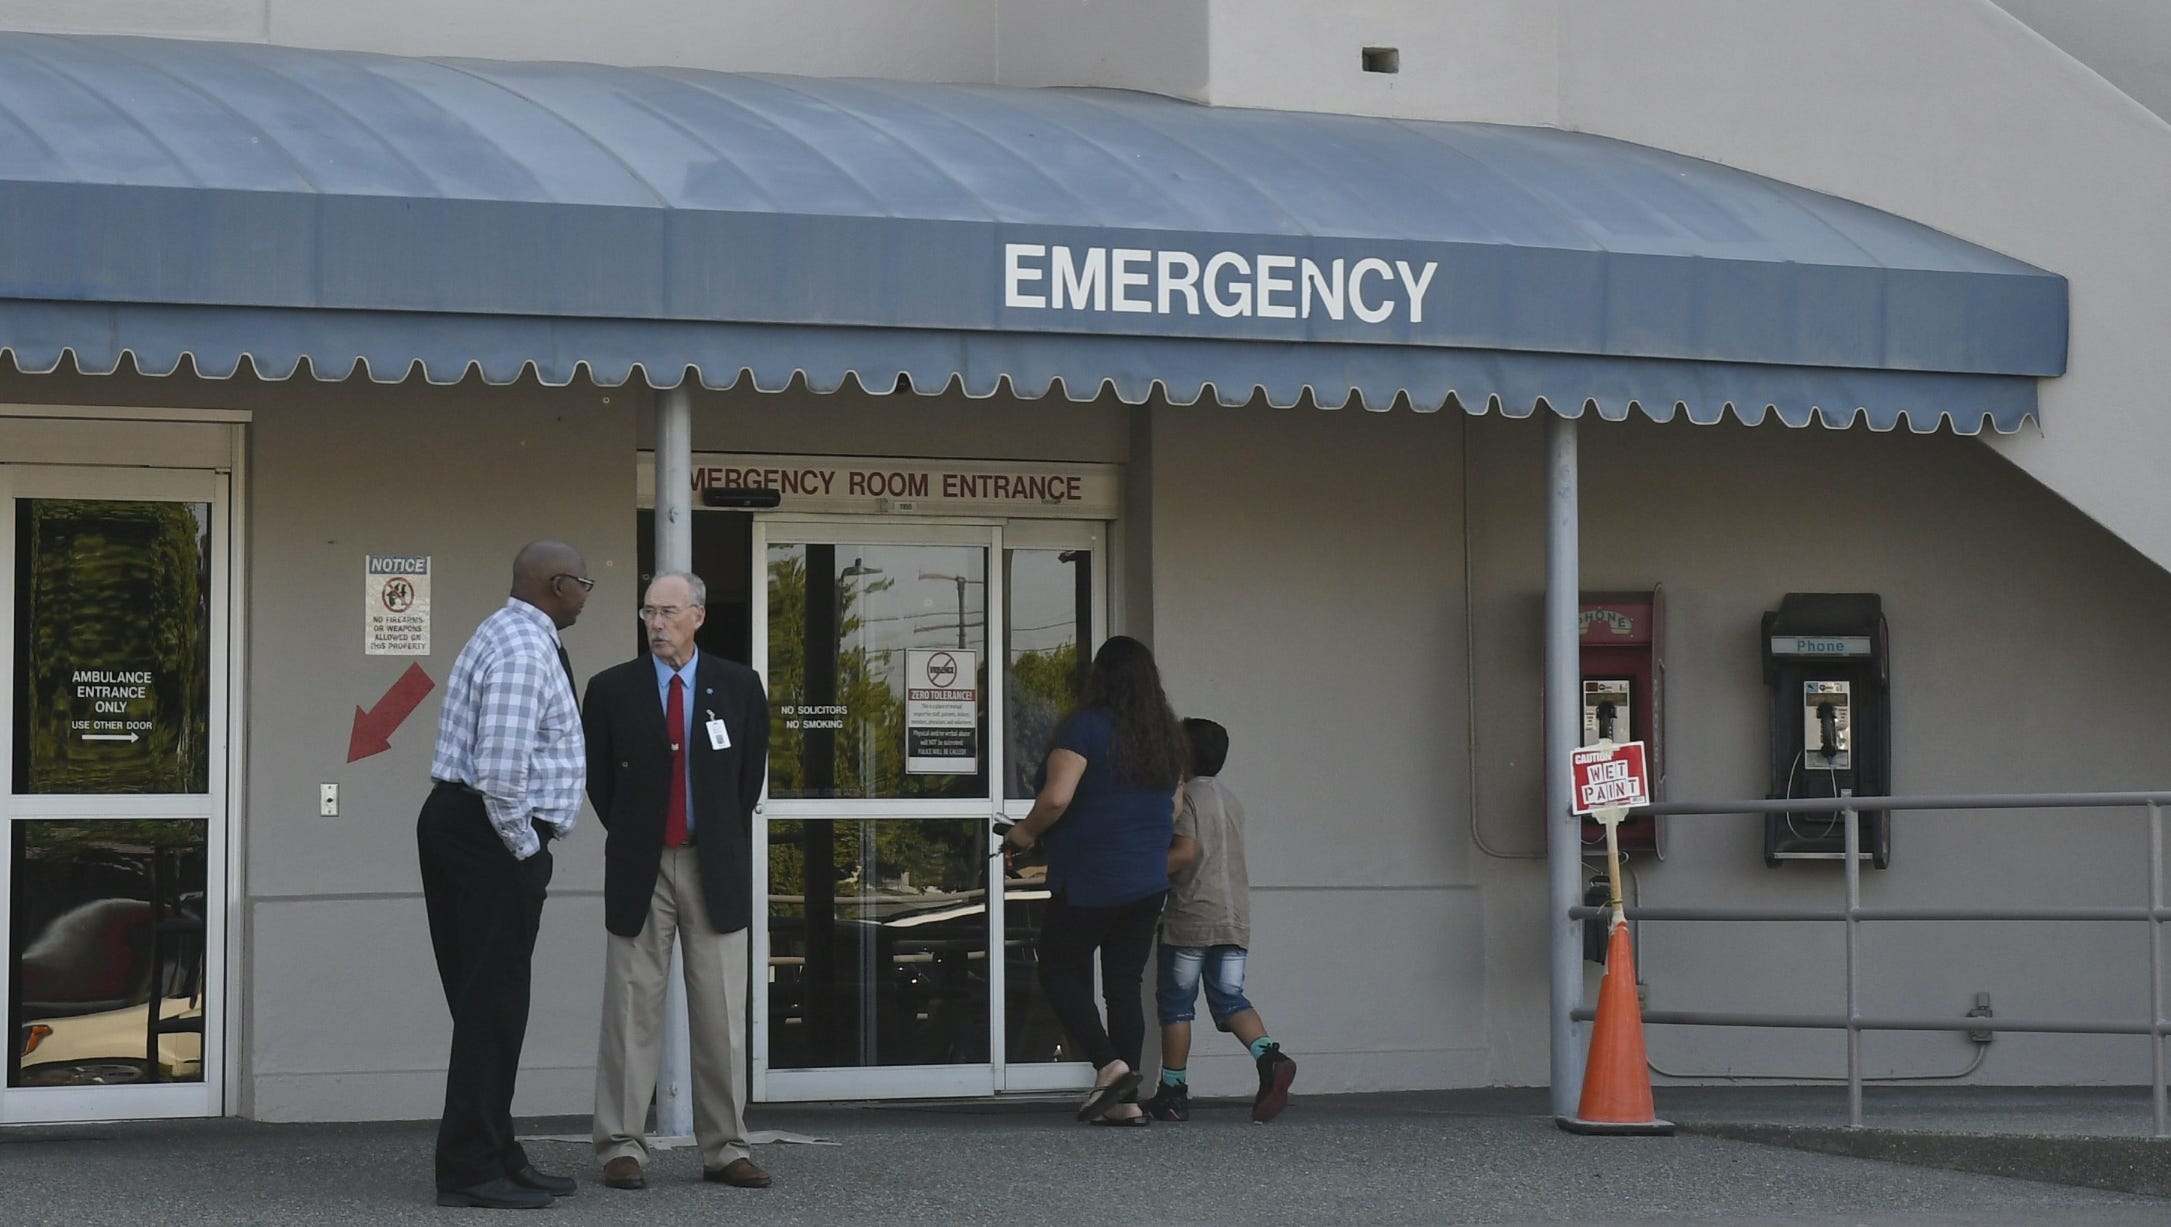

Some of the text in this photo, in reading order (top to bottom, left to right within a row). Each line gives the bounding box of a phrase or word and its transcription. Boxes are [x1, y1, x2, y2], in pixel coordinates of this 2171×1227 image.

[1005, 243, 1438, 323] EMERGENCY
[690, 467, 1082, 500] MERGENCY ROOM ENTRANCE
[371, 558, 426, 573] NOTICE
[373, 615, 383, 624] NO
[373, 625, 422, 633] OR WEAPONS
[375, 634, 408, 642] ALLOWED
[370, 642, 425, 651] THIS PROPERTY
[1797, 639, 1845, 652] Phone
[72, 670, 152, 684] AMBULANCE
[77, 685, 146, 698] ENTRANCE
[911, 690, 973, 701] ZERO TOLERANCE!
[95, 701, 127, 713] ONLY
[781, 705, 848, 715] NO SOLICITORS
[72, 721, 152, 730] USE OTHER DOOR
[786, 720, 844, 729] NO SMOKING
[1590, 762, 1626, 782] WET
[1584, 779, 1637, 802] PAINT
